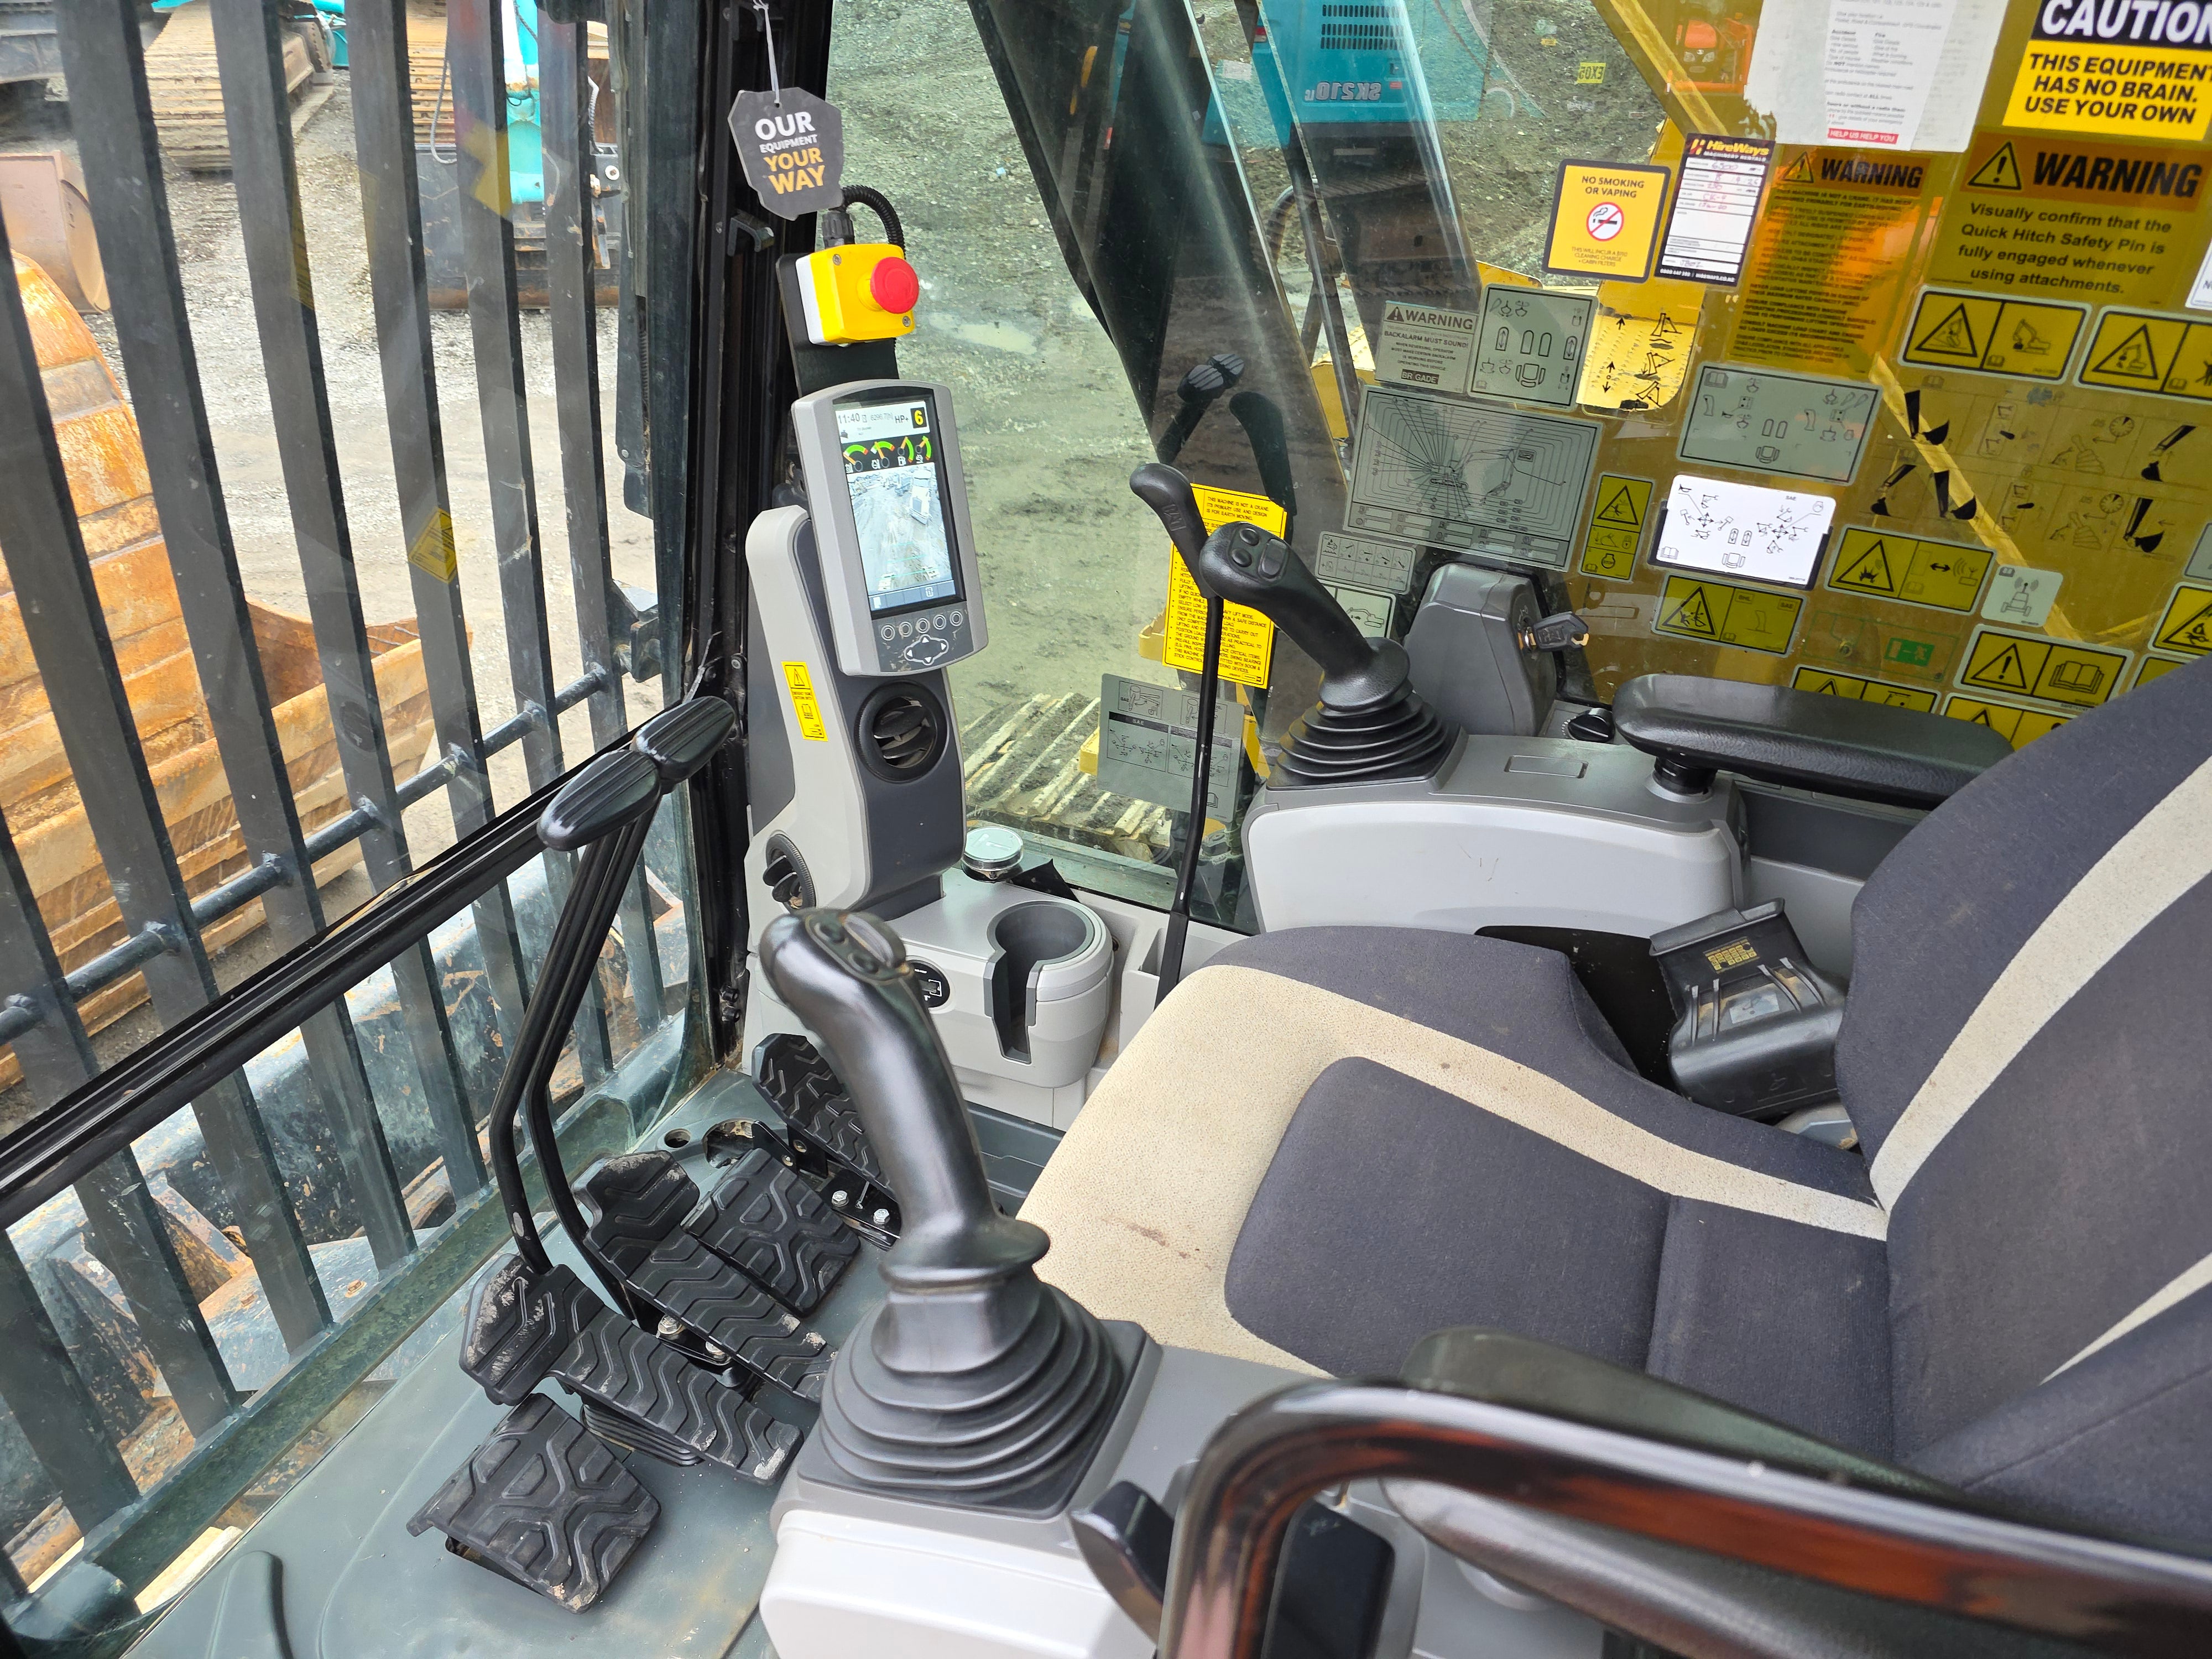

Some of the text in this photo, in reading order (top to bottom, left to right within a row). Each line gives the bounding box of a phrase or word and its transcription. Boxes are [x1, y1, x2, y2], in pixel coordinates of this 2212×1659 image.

[2030, 54, 2080, 72] THIS
[2033, 76, 2197, 102] HAS NO BRAIN.
[2025, 96, 2196, 124] USE YOUR OWN
[755, 112, 816, 140] OUR
[759, 134, 818, 153] EQUIPMENT
[1706, 140, 1769, 156] HireWays
[763, 148, 823, 171] YOUR
[768, 165, 825, 194] WAY
[1599, 177, 1645, 188] SMOKING
[1822, 158, 1923, 188] WARNING
[2033, 153, 2203, 198] WARNING
[1602, 188, 1637, 197] VAPING
[1970, 203, 2172, 233] Visually confirm that the
[1961, 224, 2165, 254] Quick Hitch Safety Pin is
[1959, 244, 2154, 275] fully engaged whenever
[1970, 269, 2125, 294] using attachments.
[1406, 310, 1473, 330] WARNING
[1385, 331, 1422, 340] BACKALARM
[1443, 340, 1469, 348] SOUND!
[838, 410, 923, 425] 11:40 HP+ 6
[1234, 639, 1254, 648] PRACTICAL
